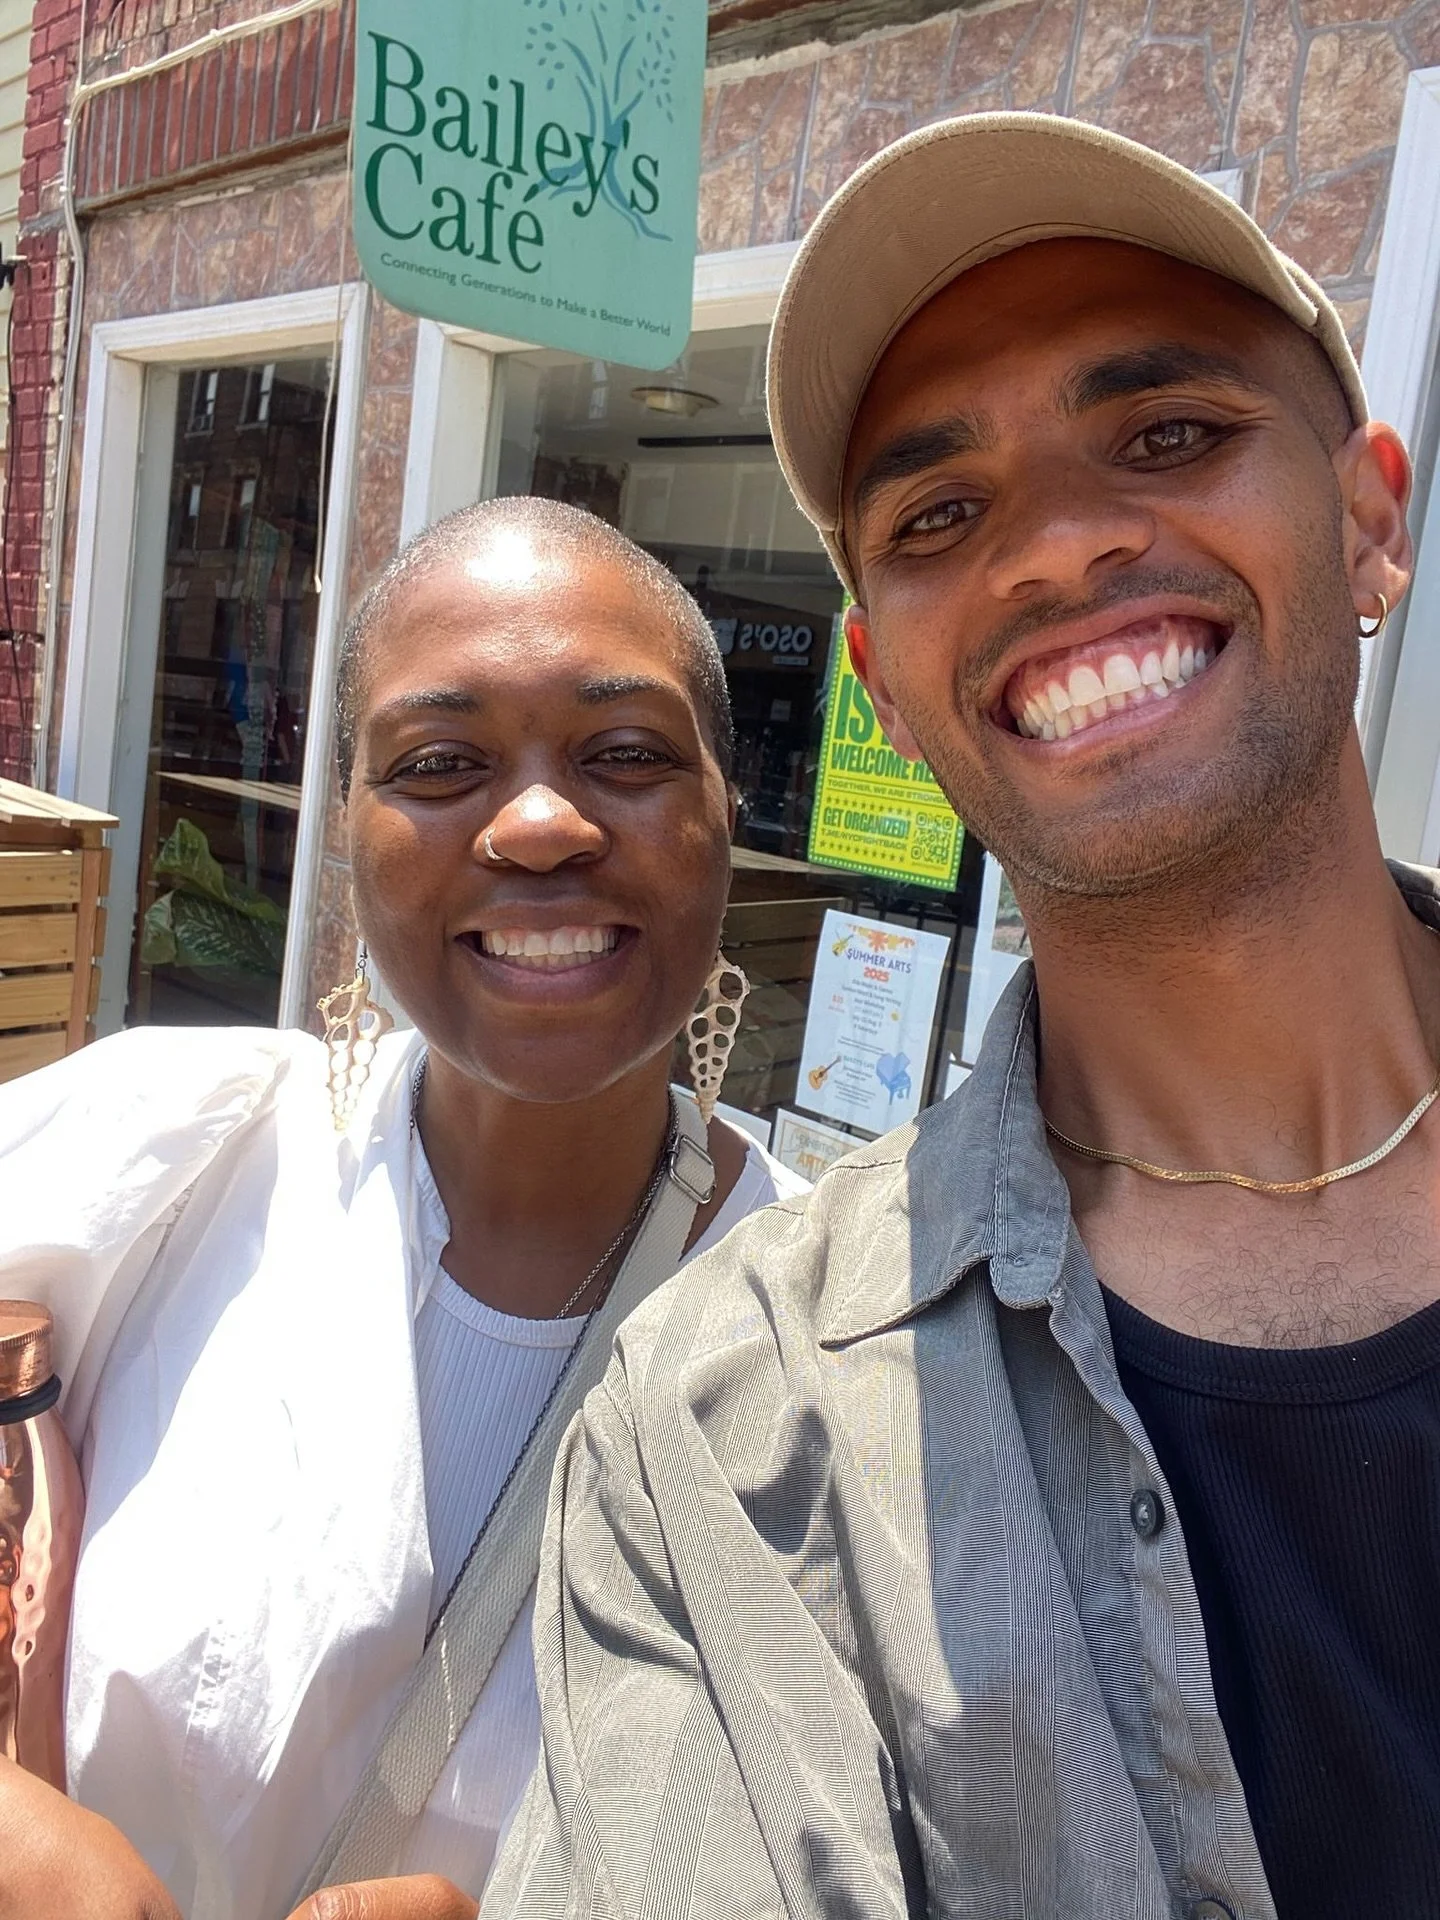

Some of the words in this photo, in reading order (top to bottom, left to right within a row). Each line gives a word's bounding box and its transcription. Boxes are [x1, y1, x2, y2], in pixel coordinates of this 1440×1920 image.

[366, 30, 660, 218] Bailey's
[365, 142, 545, 274] Café
[380, 252, 457, 287] Connecting
[461, 274, 537, 304] Generations
[540, 294, 554, 308] to
[557, 298, 588, 317] Make
[590, 309, 597, 319] a
[600, 309, 635, 328] Better
[637, 316, 671, 337] World
[831, 743, 911, 780] WELCOME
[873, 786, 887, 795] WE
[888, 788, 905, 798] ARE
[823, 806, 844, 827] GET
[844, 810, 911, 840] ORGANIZED!
[846, 948, 886, 968] SUMMER
[888, 960, 912, 974] ARTS
[863, 966, 890, 983] 2025
